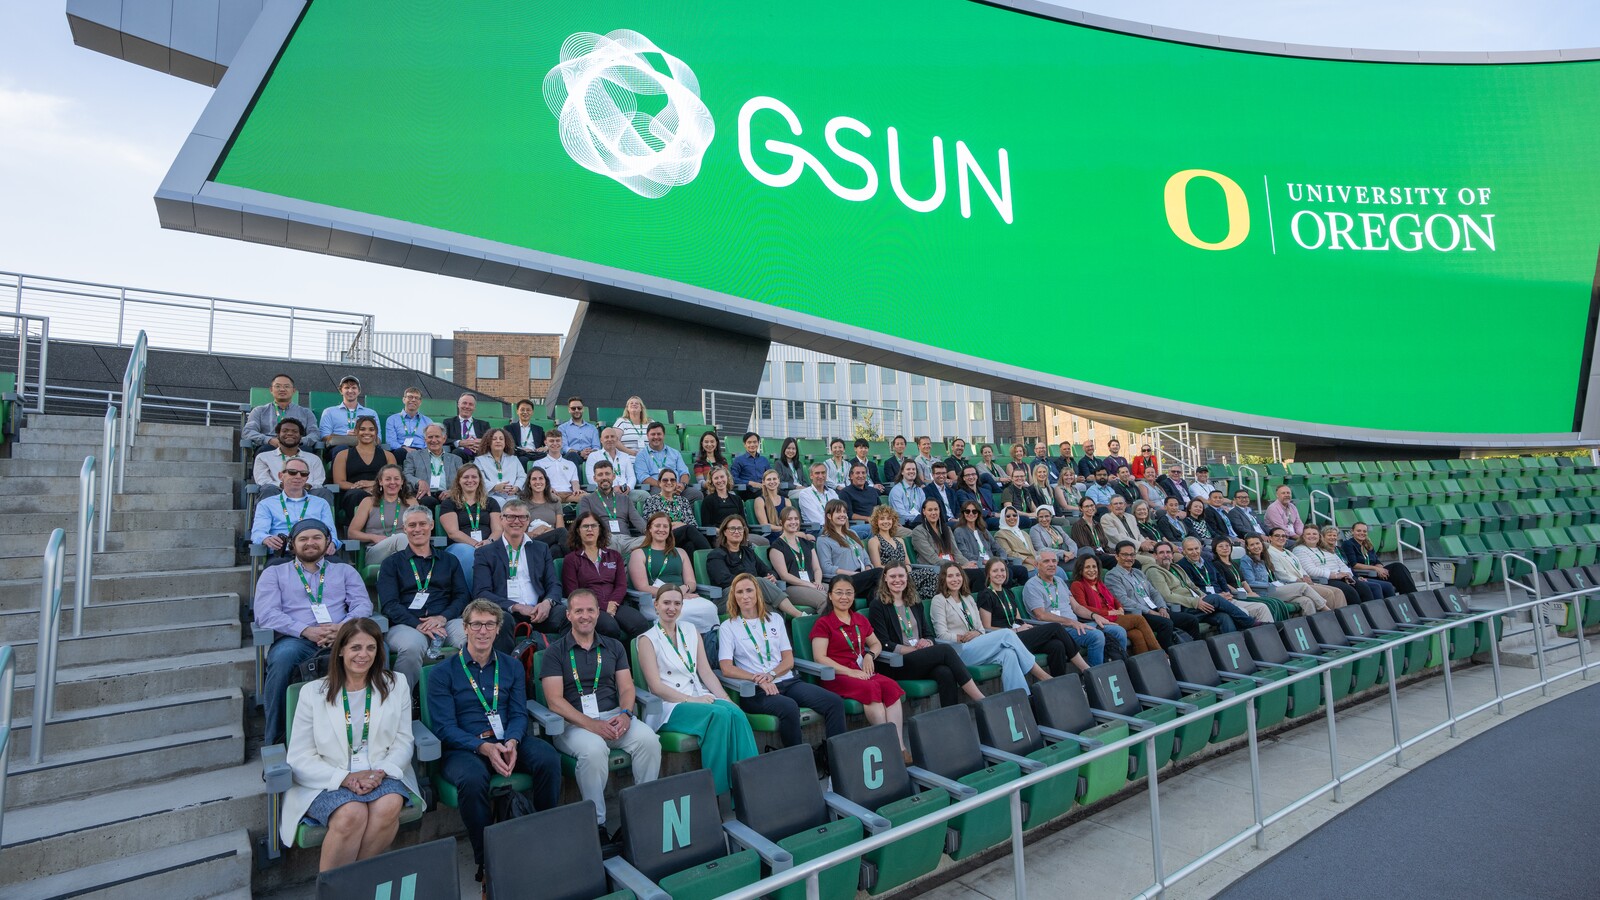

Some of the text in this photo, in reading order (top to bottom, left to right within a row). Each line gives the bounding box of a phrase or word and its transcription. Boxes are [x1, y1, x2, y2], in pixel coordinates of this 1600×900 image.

[738, 96, 1013, 224] GSUN
[1164, 169, 1250, 251] O
[1287, 183, 1491, 206] UNIVERSITY OF
[1291, 210, 1496, 252] OREGON
